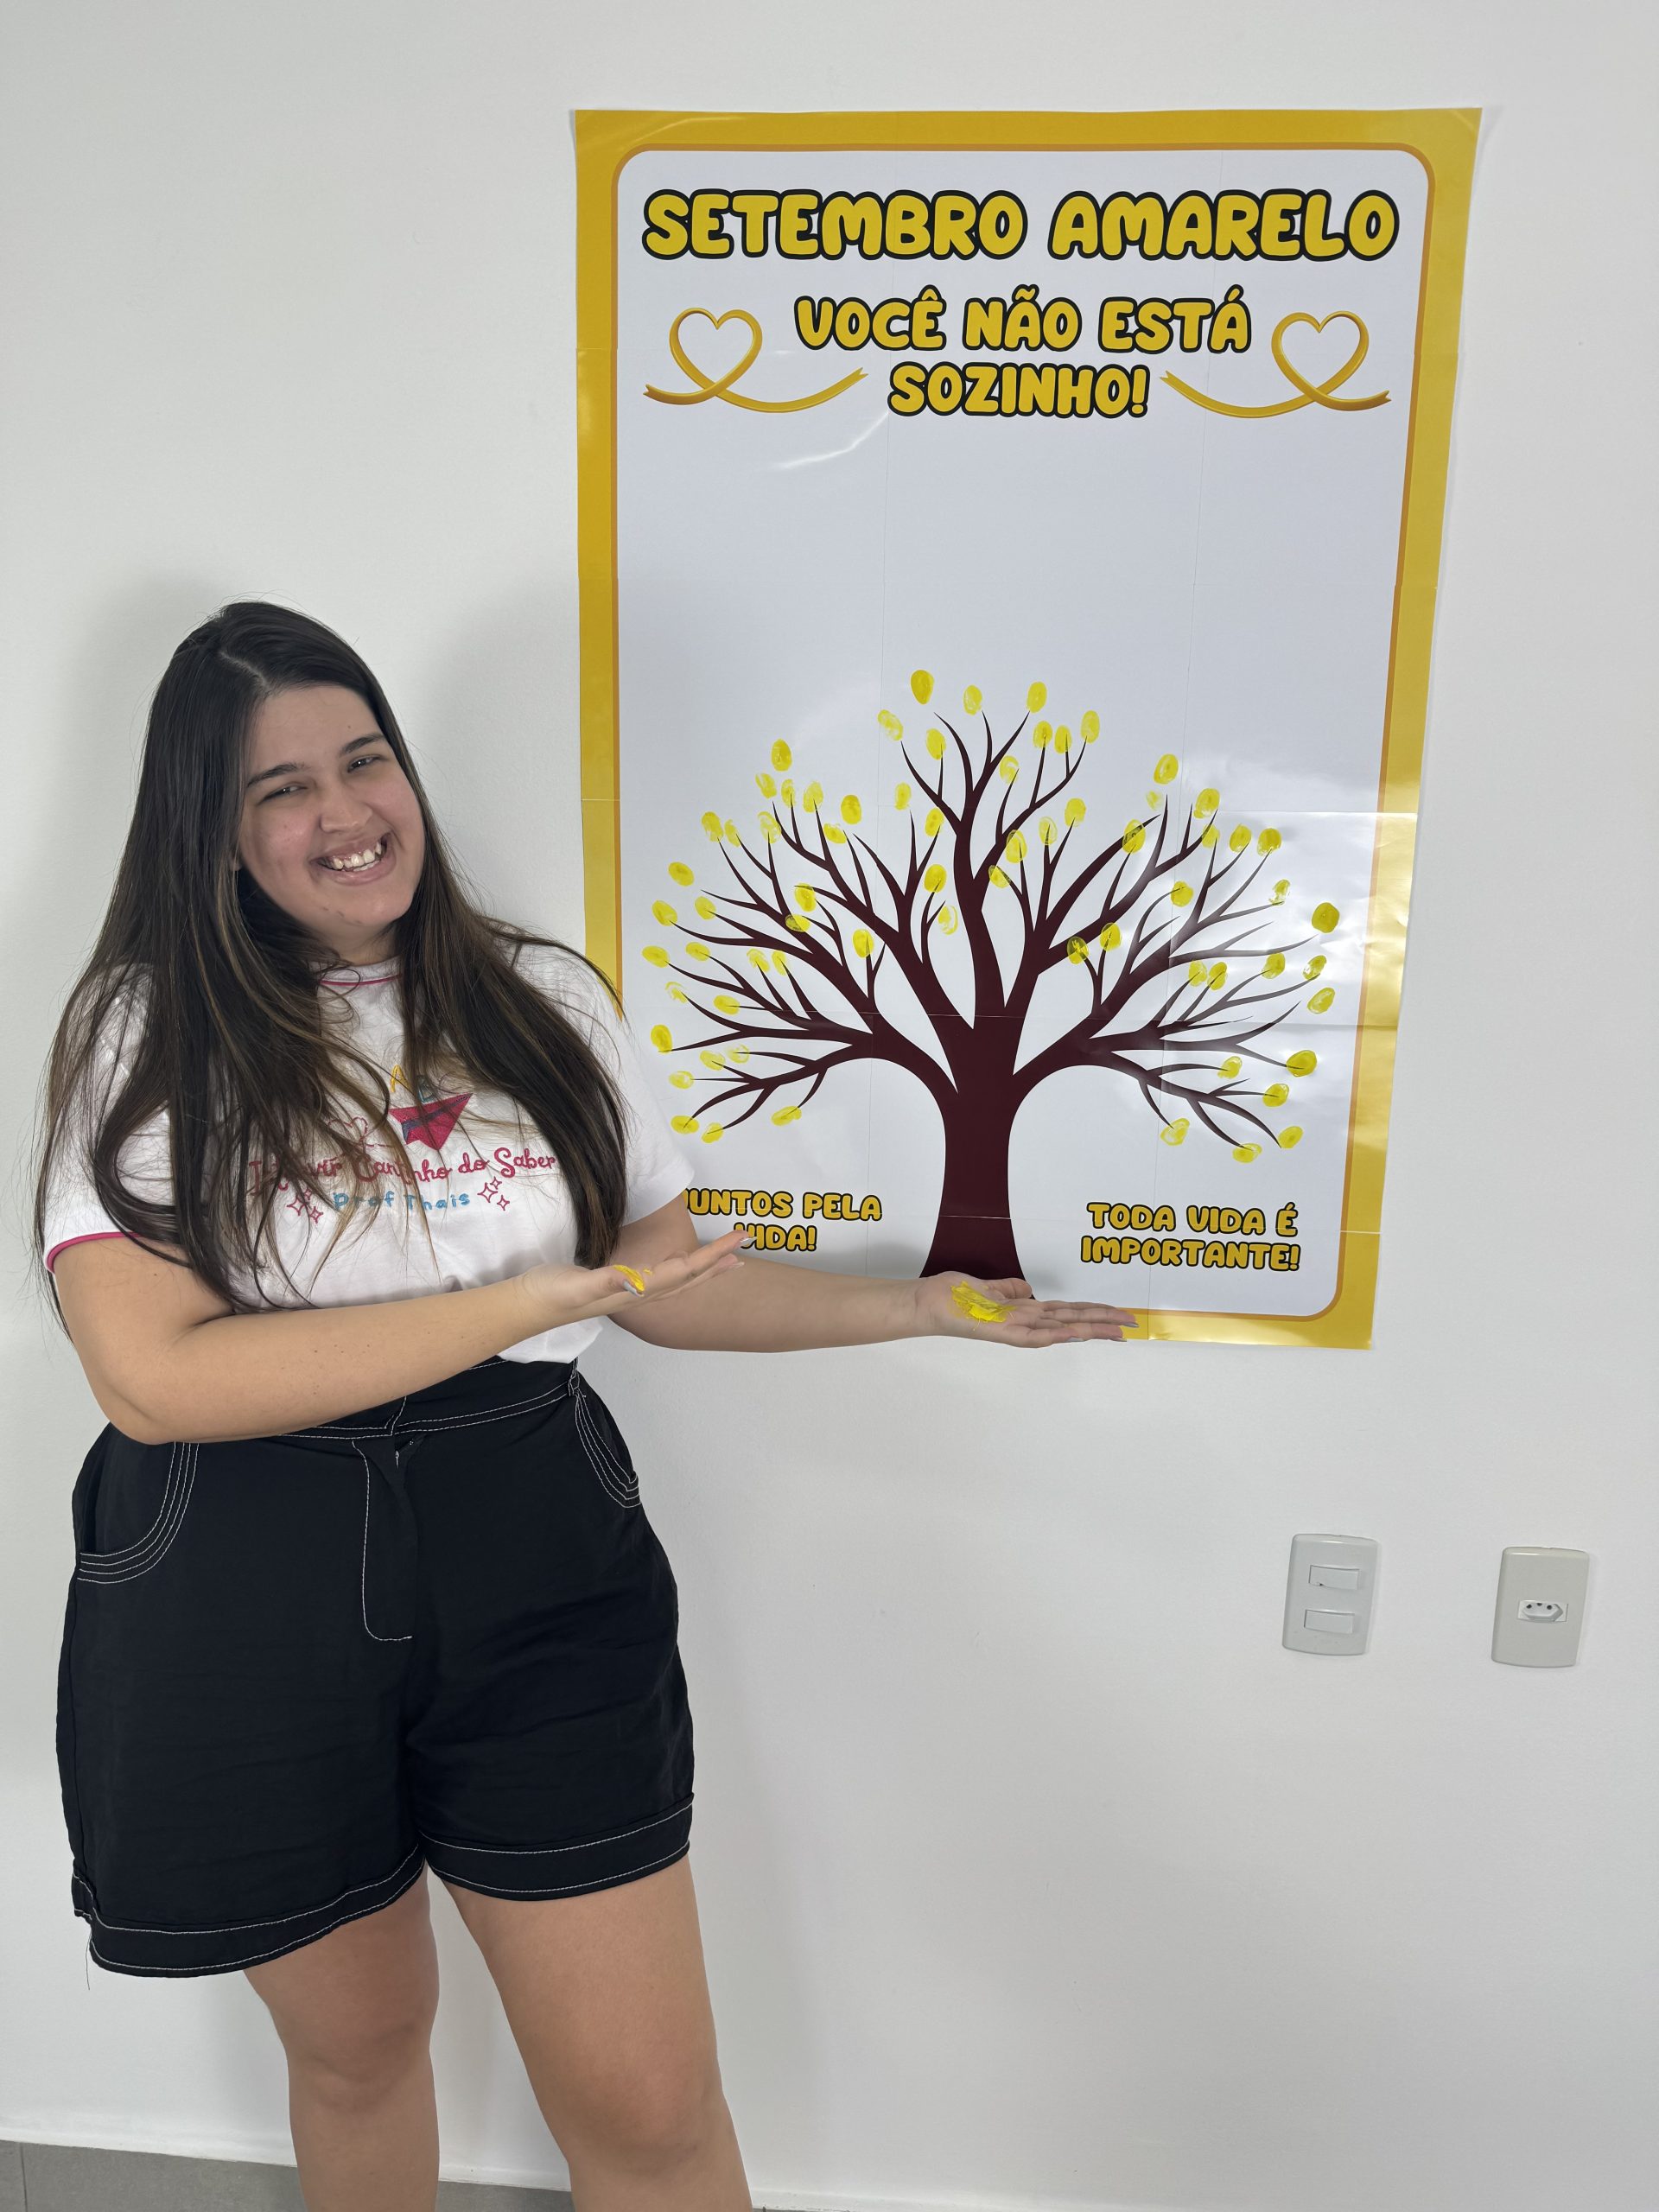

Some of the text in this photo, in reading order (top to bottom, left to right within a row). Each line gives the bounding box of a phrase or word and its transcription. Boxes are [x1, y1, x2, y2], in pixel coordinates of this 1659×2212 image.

[644, 188, 1400, 262] SETEMBRO AMARELO
[793, 284, 1253, 353] VOCÊ NÃO ESTÁ
[888, 361, 1150, 418] SOZINHO!
[458, 1152, 490, 1173] do
[493, 1147, 556, 1178] Saber
[802, 1192, 882, 1221] PELA
[1086, 1202, 1298, 1237] TODA VIDA É
[1080, 1236, 1301, 1272] IMPORTANTE!
